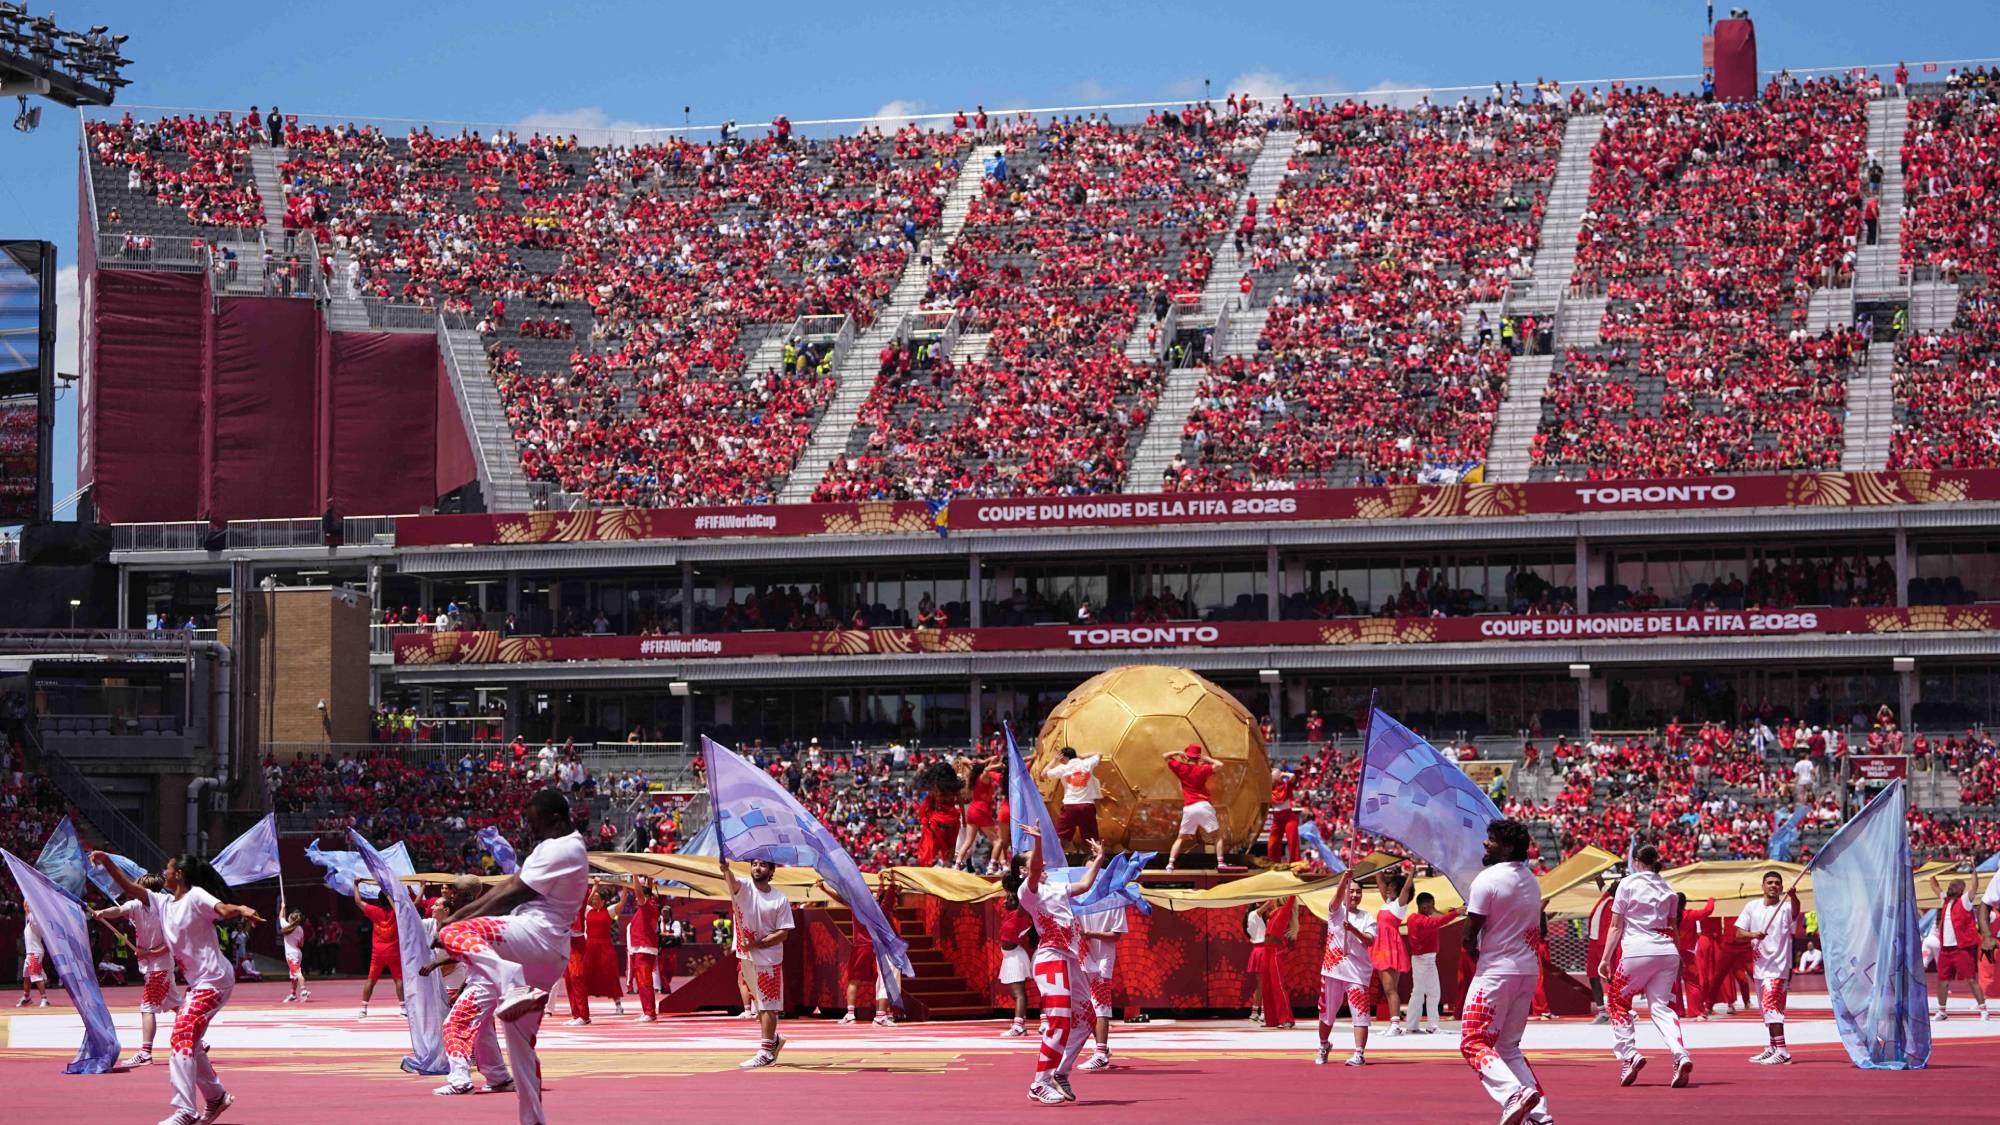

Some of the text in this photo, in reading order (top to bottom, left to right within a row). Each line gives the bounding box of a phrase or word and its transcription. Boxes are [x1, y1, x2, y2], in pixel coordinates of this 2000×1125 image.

[1576, 484, 1735, 504] TORONTO
[978, 498, 1297, 522] COUPE DU MONDE DE LA FIFA 2026
[695, 514, 776, 529] #FIFAWorldCup
[1481, 612, 1818, 636] COUPE DU MONDE DE LA FIFA 2026
[1068, 626, 1219, 644] TORONTO
[641, 638, 721, 654] #FIFAWorldCup
[1035, 959, 1072, 1072] FIFA
